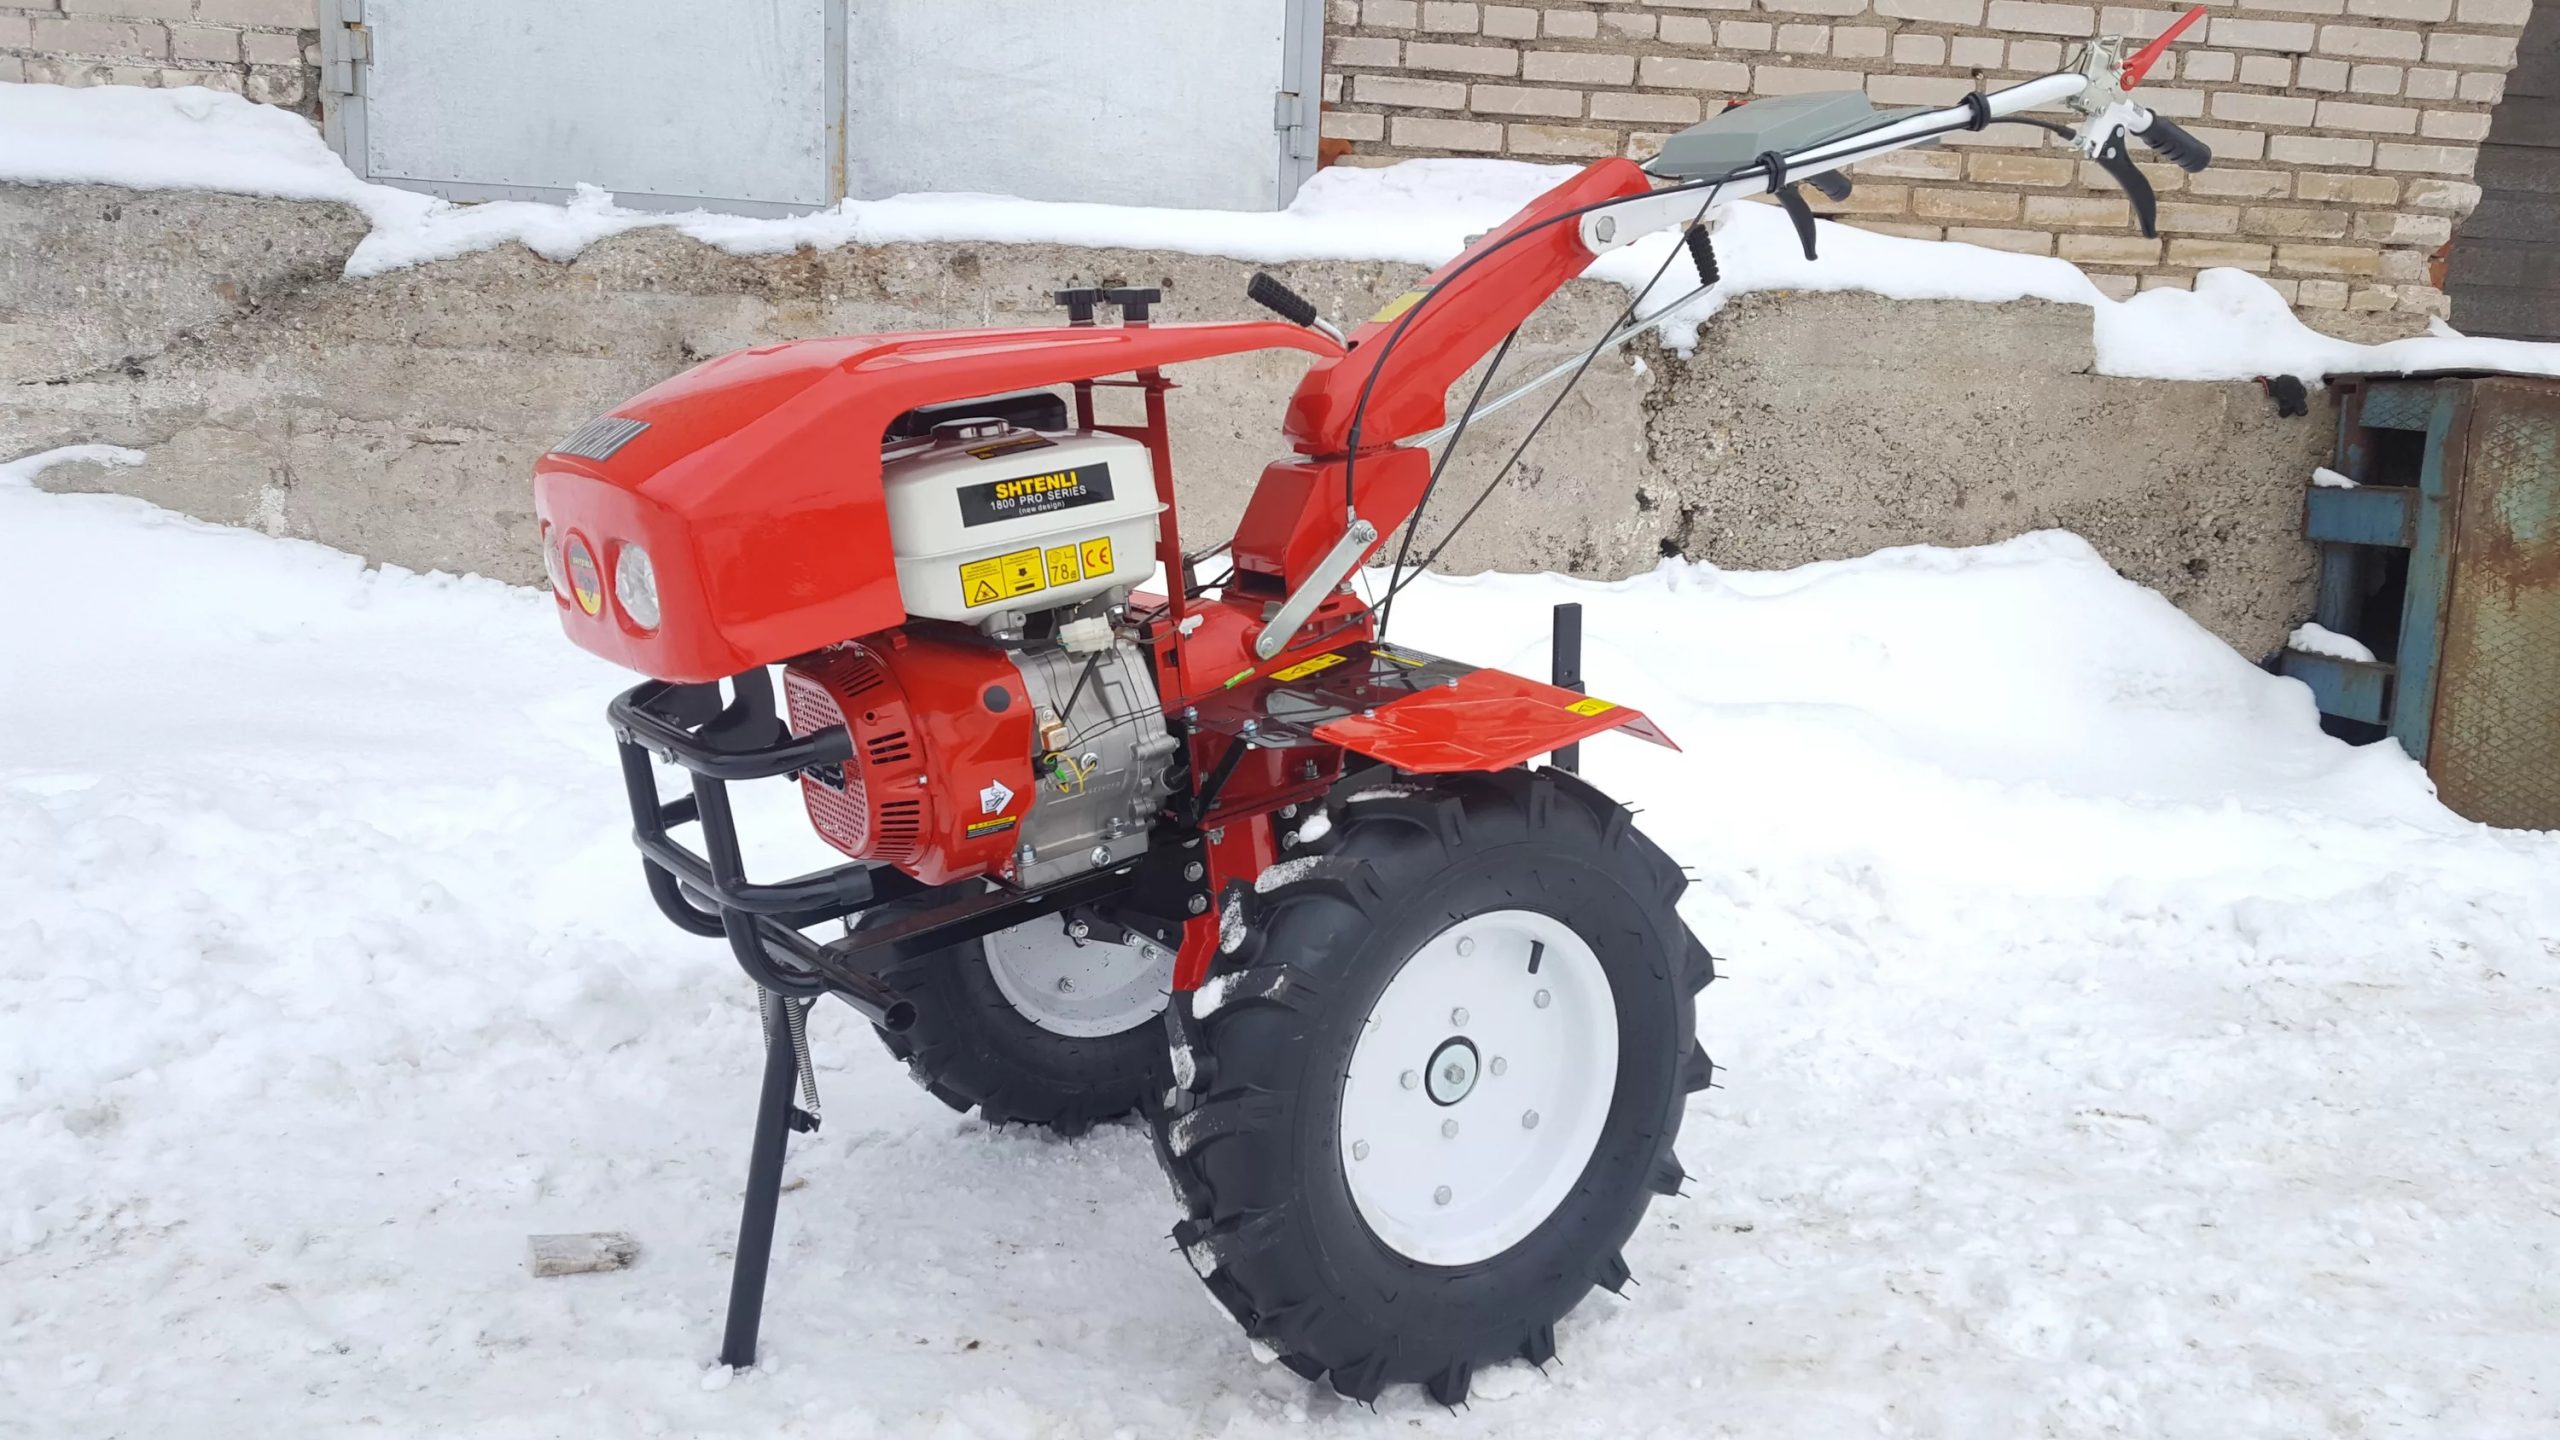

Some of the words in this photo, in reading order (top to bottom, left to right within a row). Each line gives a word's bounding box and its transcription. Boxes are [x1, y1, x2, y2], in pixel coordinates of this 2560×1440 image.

[990, 498, 1015, 511] 1800
[1019, 493, 1043, 506] PRO
[1047, 485, 1087, 500] SERIES
[995, 471, 1078, 499] SHTENLI
[1018, 506, 1037, 516] (new
[1038, 501, 1065, 514] design)
